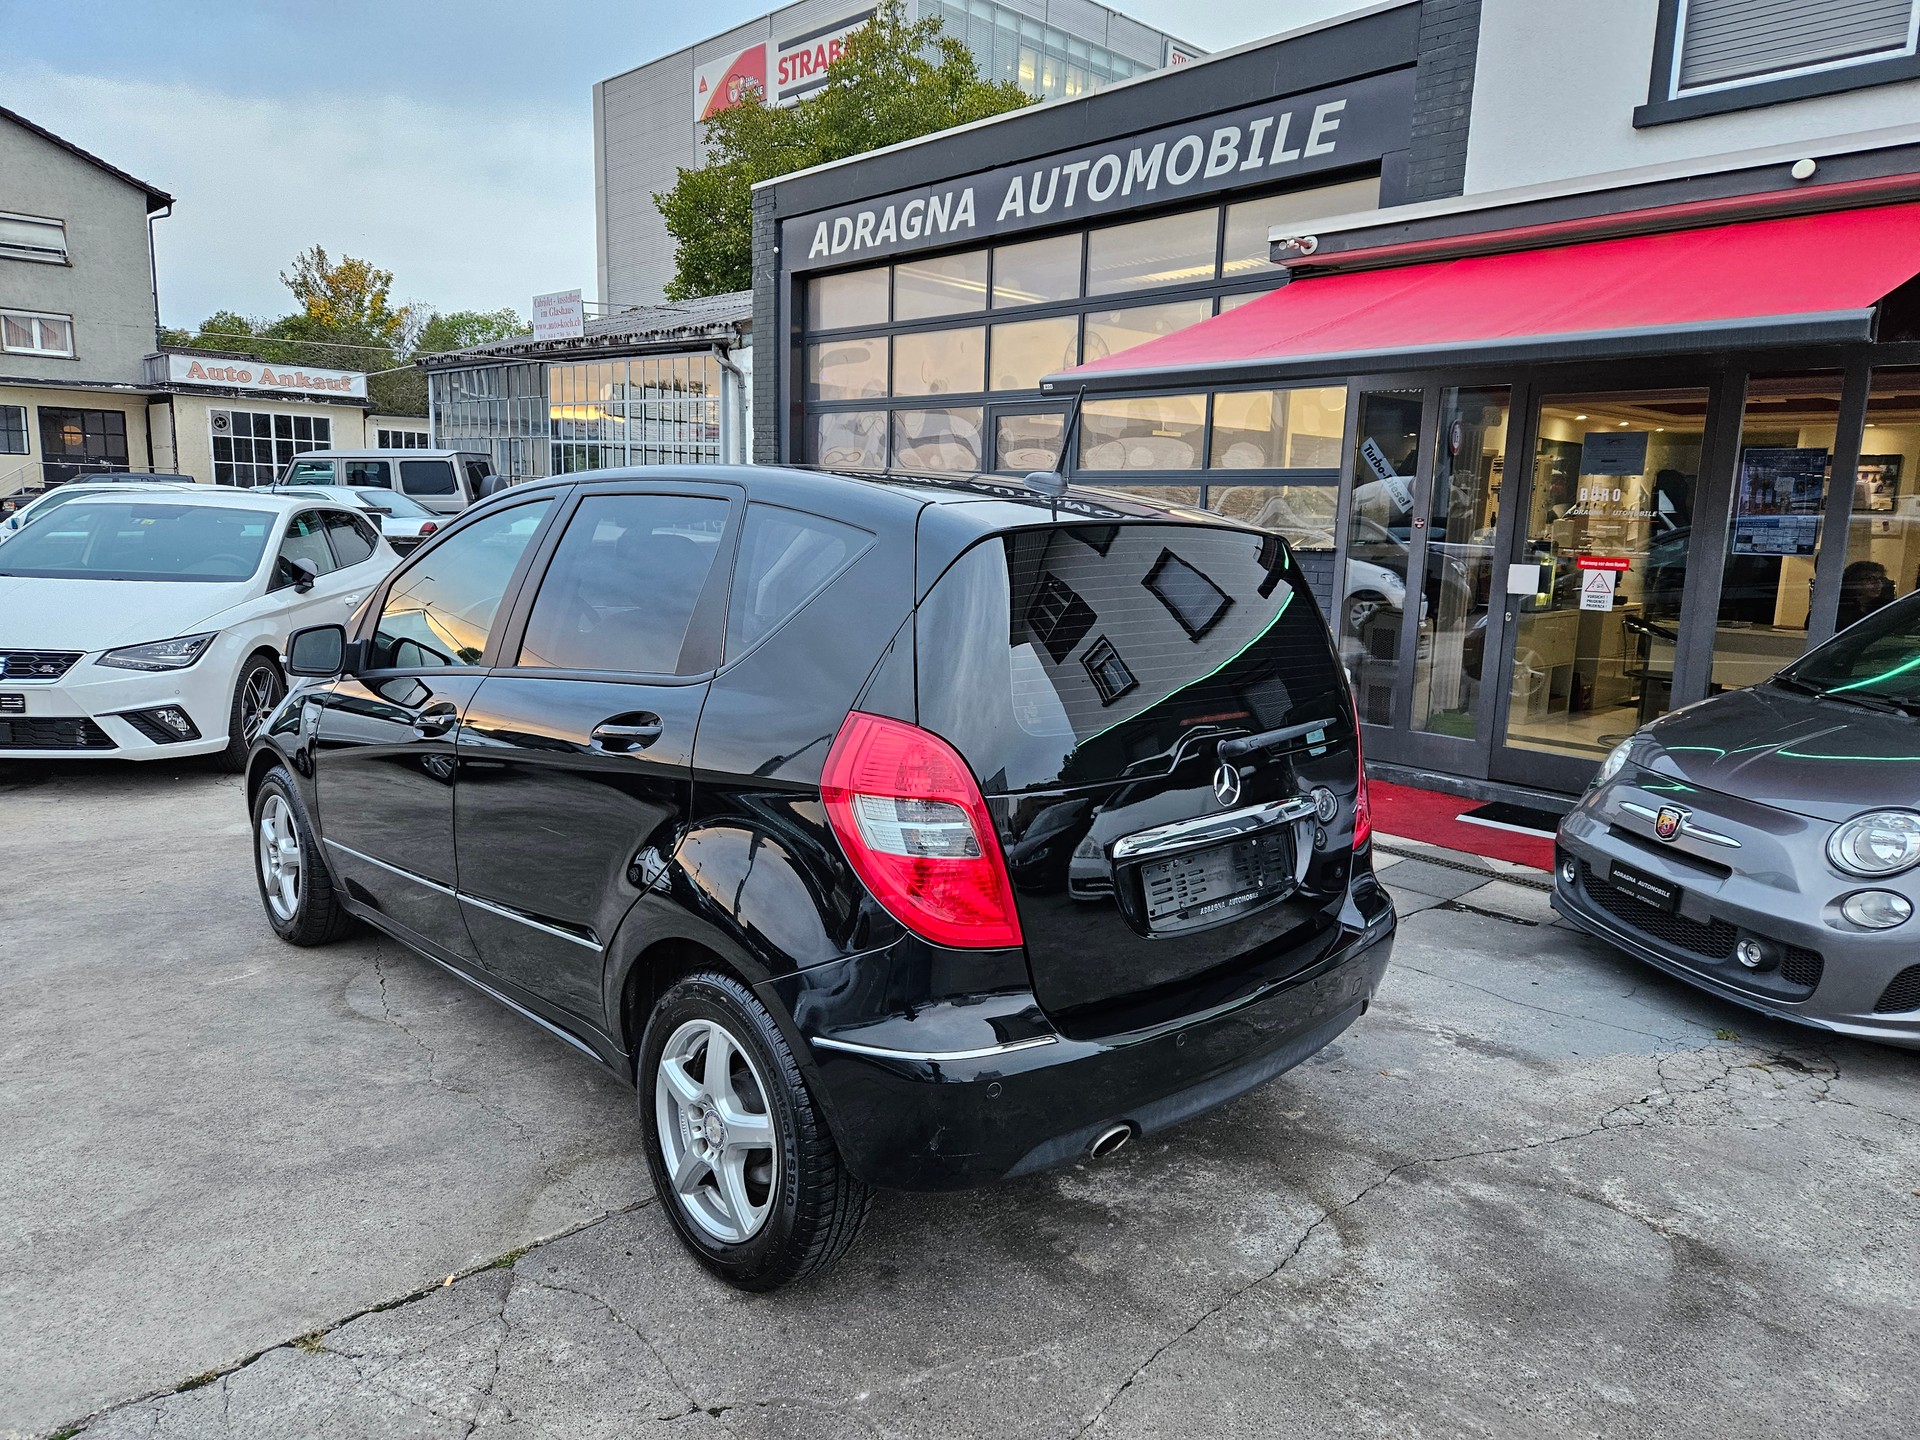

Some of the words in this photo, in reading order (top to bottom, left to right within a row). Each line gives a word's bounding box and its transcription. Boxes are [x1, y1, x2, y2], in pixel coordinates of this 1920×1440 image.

[808, 188, 975, 259] ADRAGNA
[996, 99, 1347, 221] AUTOMOBILE
[535, 316, 581, 330] www.auto-koch.ch
[541, 309, 548, 317] im
[549, 306, 574, 317] Glashaus
[187, 360, 252, 383] Auto
[258, 368, 352, 392] Ankauf
[1363, 443, 1411, 508] Turbo-Diesel
[1613, 869, 1636, 884] ADRAGNA
[1637, 880, 1671, 899] AUTOMOBILE
[1200, 901, 1225, 915] ADRAGNA
[1228, 892, 1259, 908] AUTOMOBILE
[786, 1144, 796, 1207] TS810
